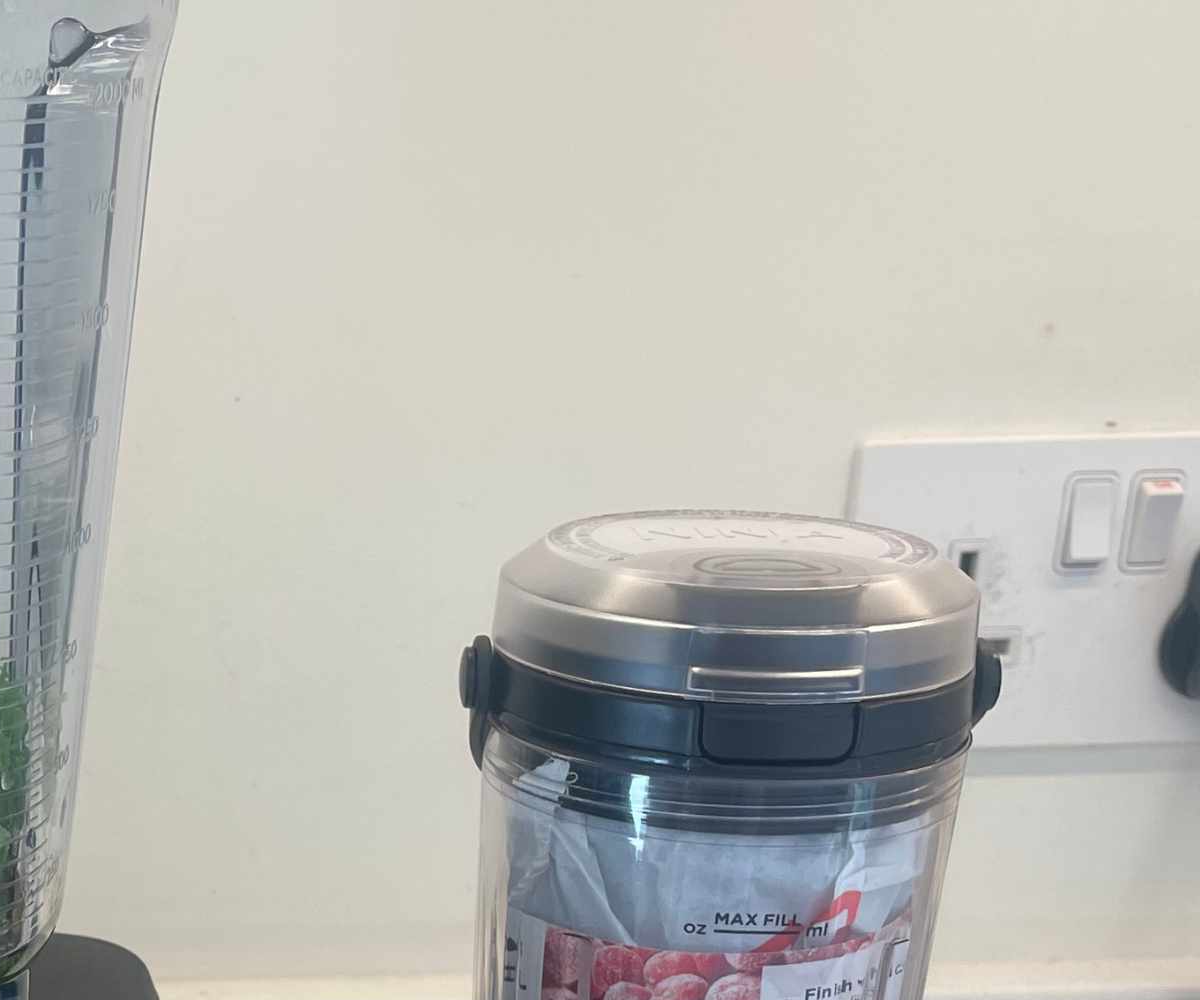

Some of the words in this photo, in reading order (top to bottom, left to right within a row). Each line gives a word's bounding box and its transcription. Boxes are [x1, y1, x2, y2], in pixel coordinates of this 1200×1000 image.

[714, 912, 758, 927] MAX
[763, 913, 801, 928] FILL
[683, 923, 707, 935] oz
[806, 922, 829, 937] ml
